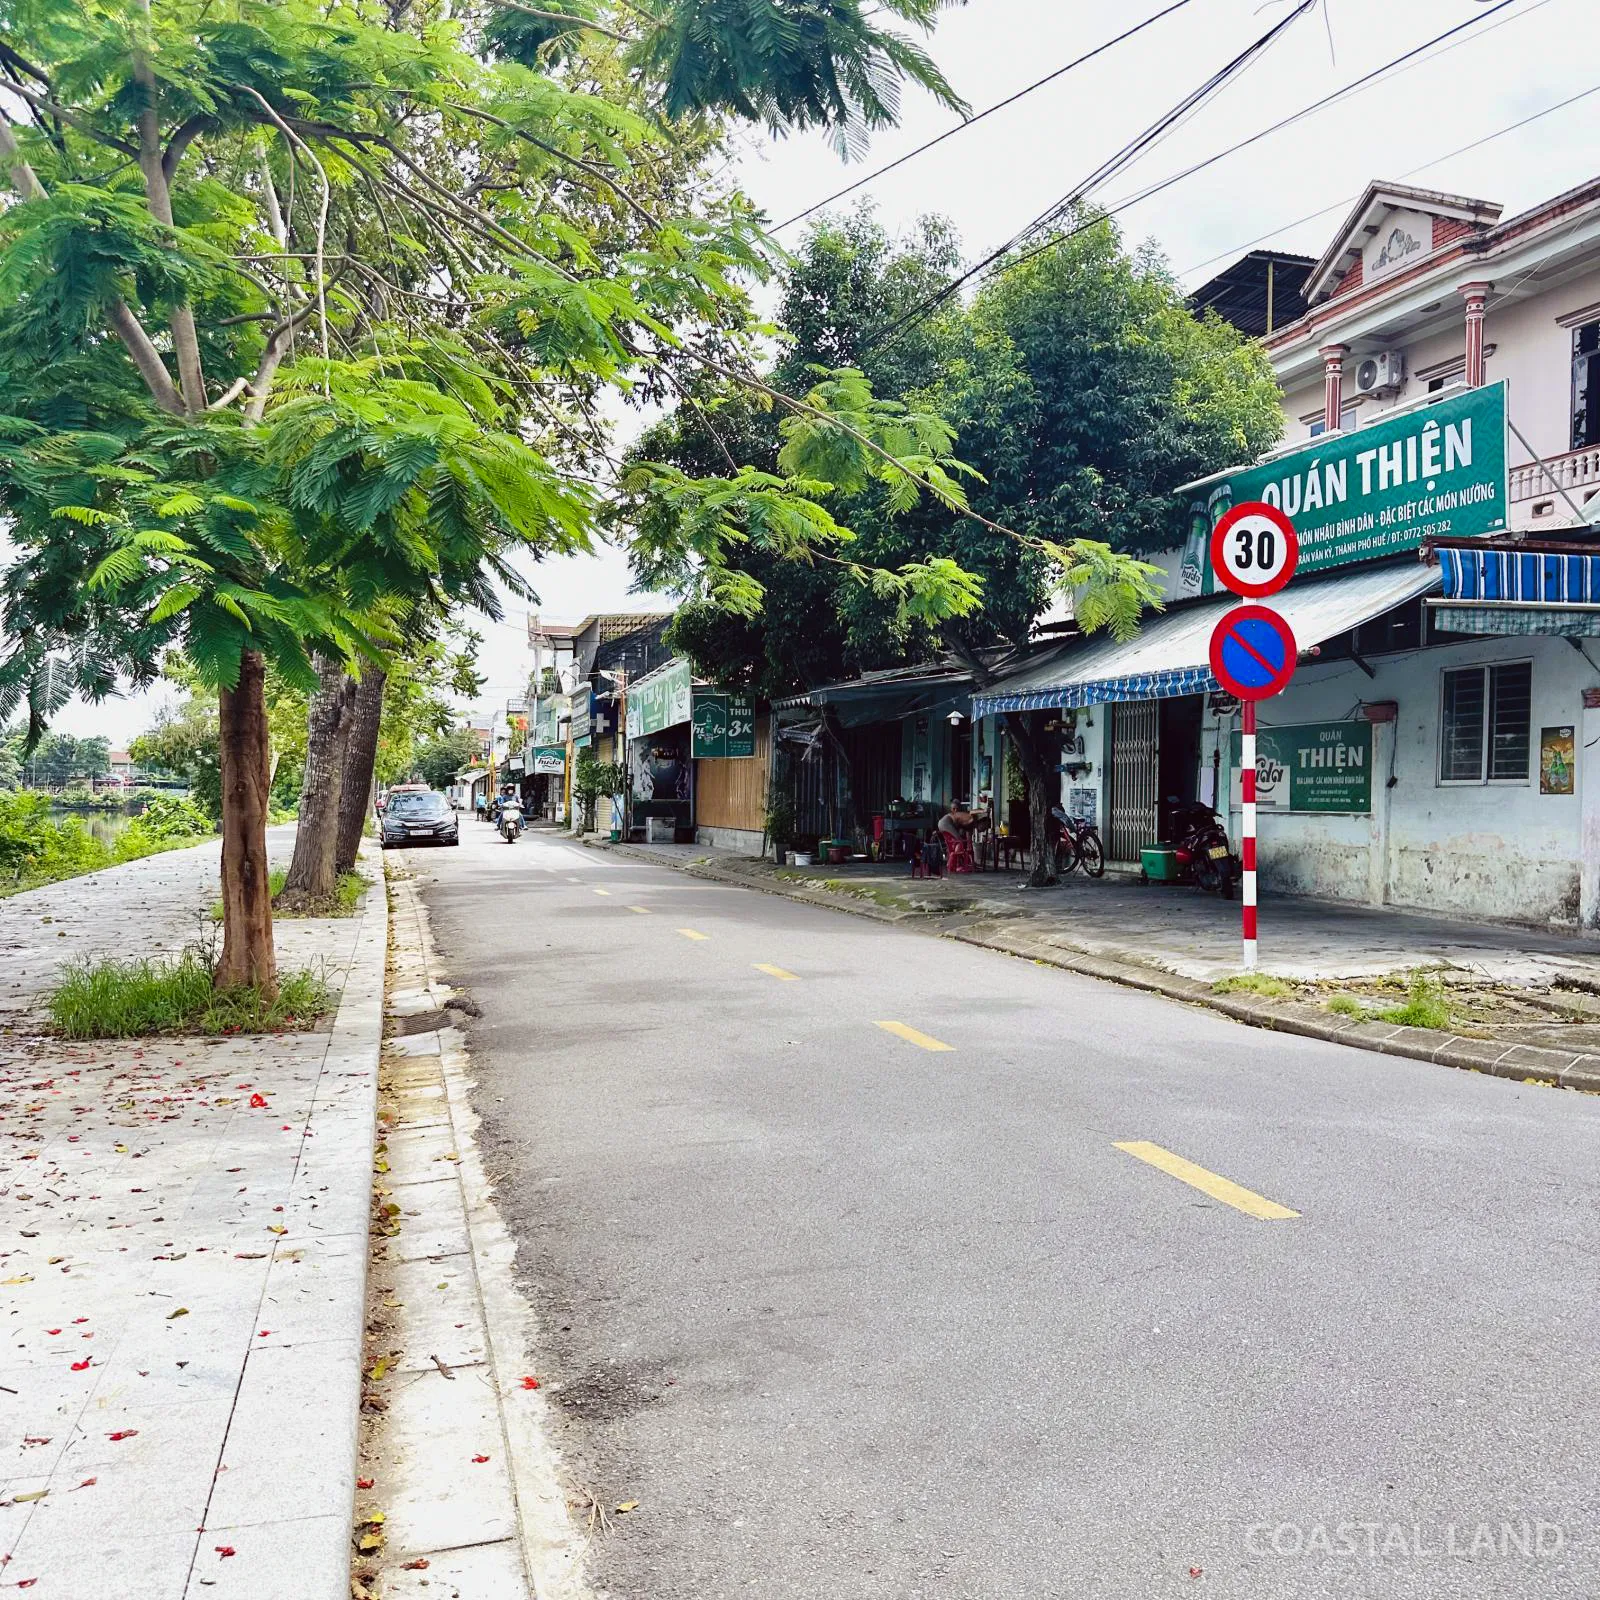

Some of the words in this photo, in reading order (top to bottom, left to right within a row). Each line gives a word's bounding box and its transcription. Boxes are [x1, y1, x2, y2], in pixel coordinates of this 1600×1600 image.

[1261, 458, 1347, 518] QUÁN
[1356, 417, 1472, 491] THIỆN
[1314, 522, 1335, 544] NHẬU
[1336, 518, 1356, 538] BÌNH
[1357, 511, 1374, 532] DÂN
[1380, 505, 1398, 529] ĐẶC
[1398, 500, 1417, 524] BIỆT
[1418, 495, 1435, 517] CÁC
[1436, 489, 1458, 513] MÓN
[1459, 481, 1495, 507] NƯỚNG
[1235, 530, 1275, 570] 30
[1335, 539, 1357, 557] THÀNH
[1357, 534, 1372, 551] PHỐ
[1372, 530, 1386, 547] HUẾ
[1403, 526, 1421, 540] 0772
[1422, 522, 1436, 537] 505
[1437, 518, 1451, 533] 282
[728, 720, 753, 737] 3K
[729, 708, 752, 716] THUI
[1240, 757, 1284, 783] da
[1297, 743, 1364, 773] THIỆN
